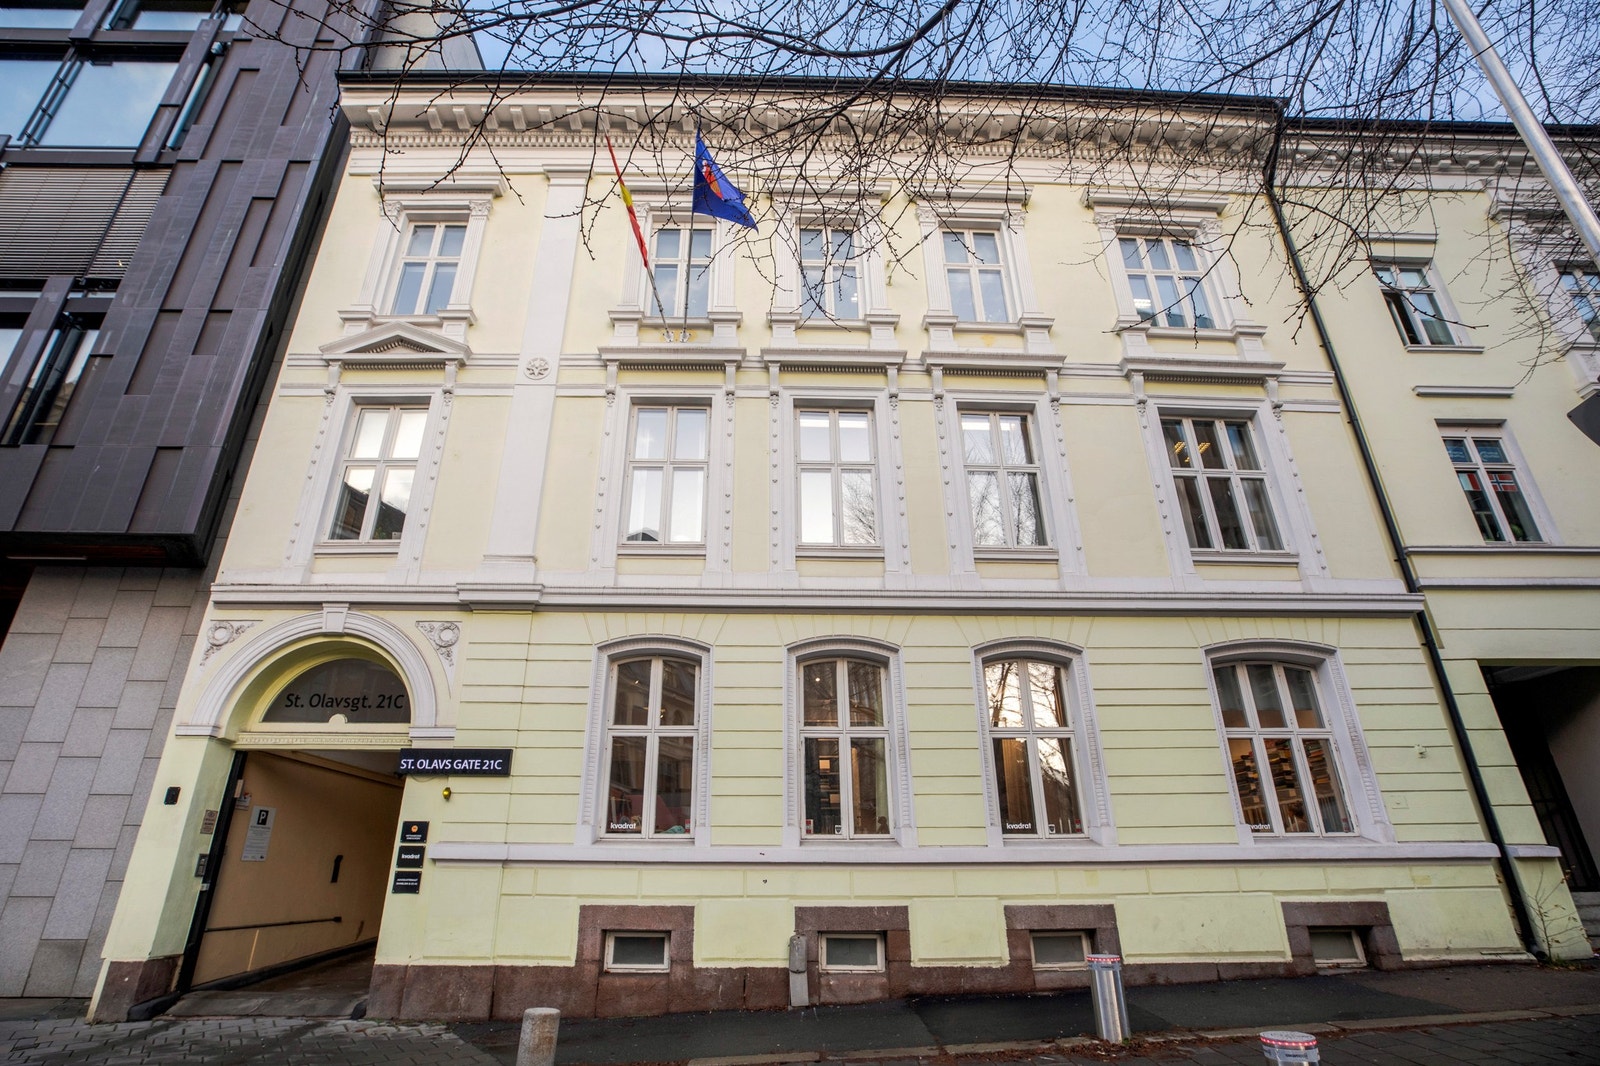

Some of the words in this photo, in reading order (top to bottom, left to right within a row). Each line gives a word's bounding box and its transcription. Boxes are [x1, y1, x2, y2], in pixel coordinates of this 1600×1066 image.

[285, 693, 304, 708] St.
[309, 693, 372, 712] Olavsgt.
[376, 694, 404, 709] 21C
[400, 759, 414, 770] ST.
[416, 759, 452, 770] OLAVS
[453, 759, 481, 770] GATE
[482, 759, 503, 770] 21C
[1006, 822, 1031, 830] kvadrat
